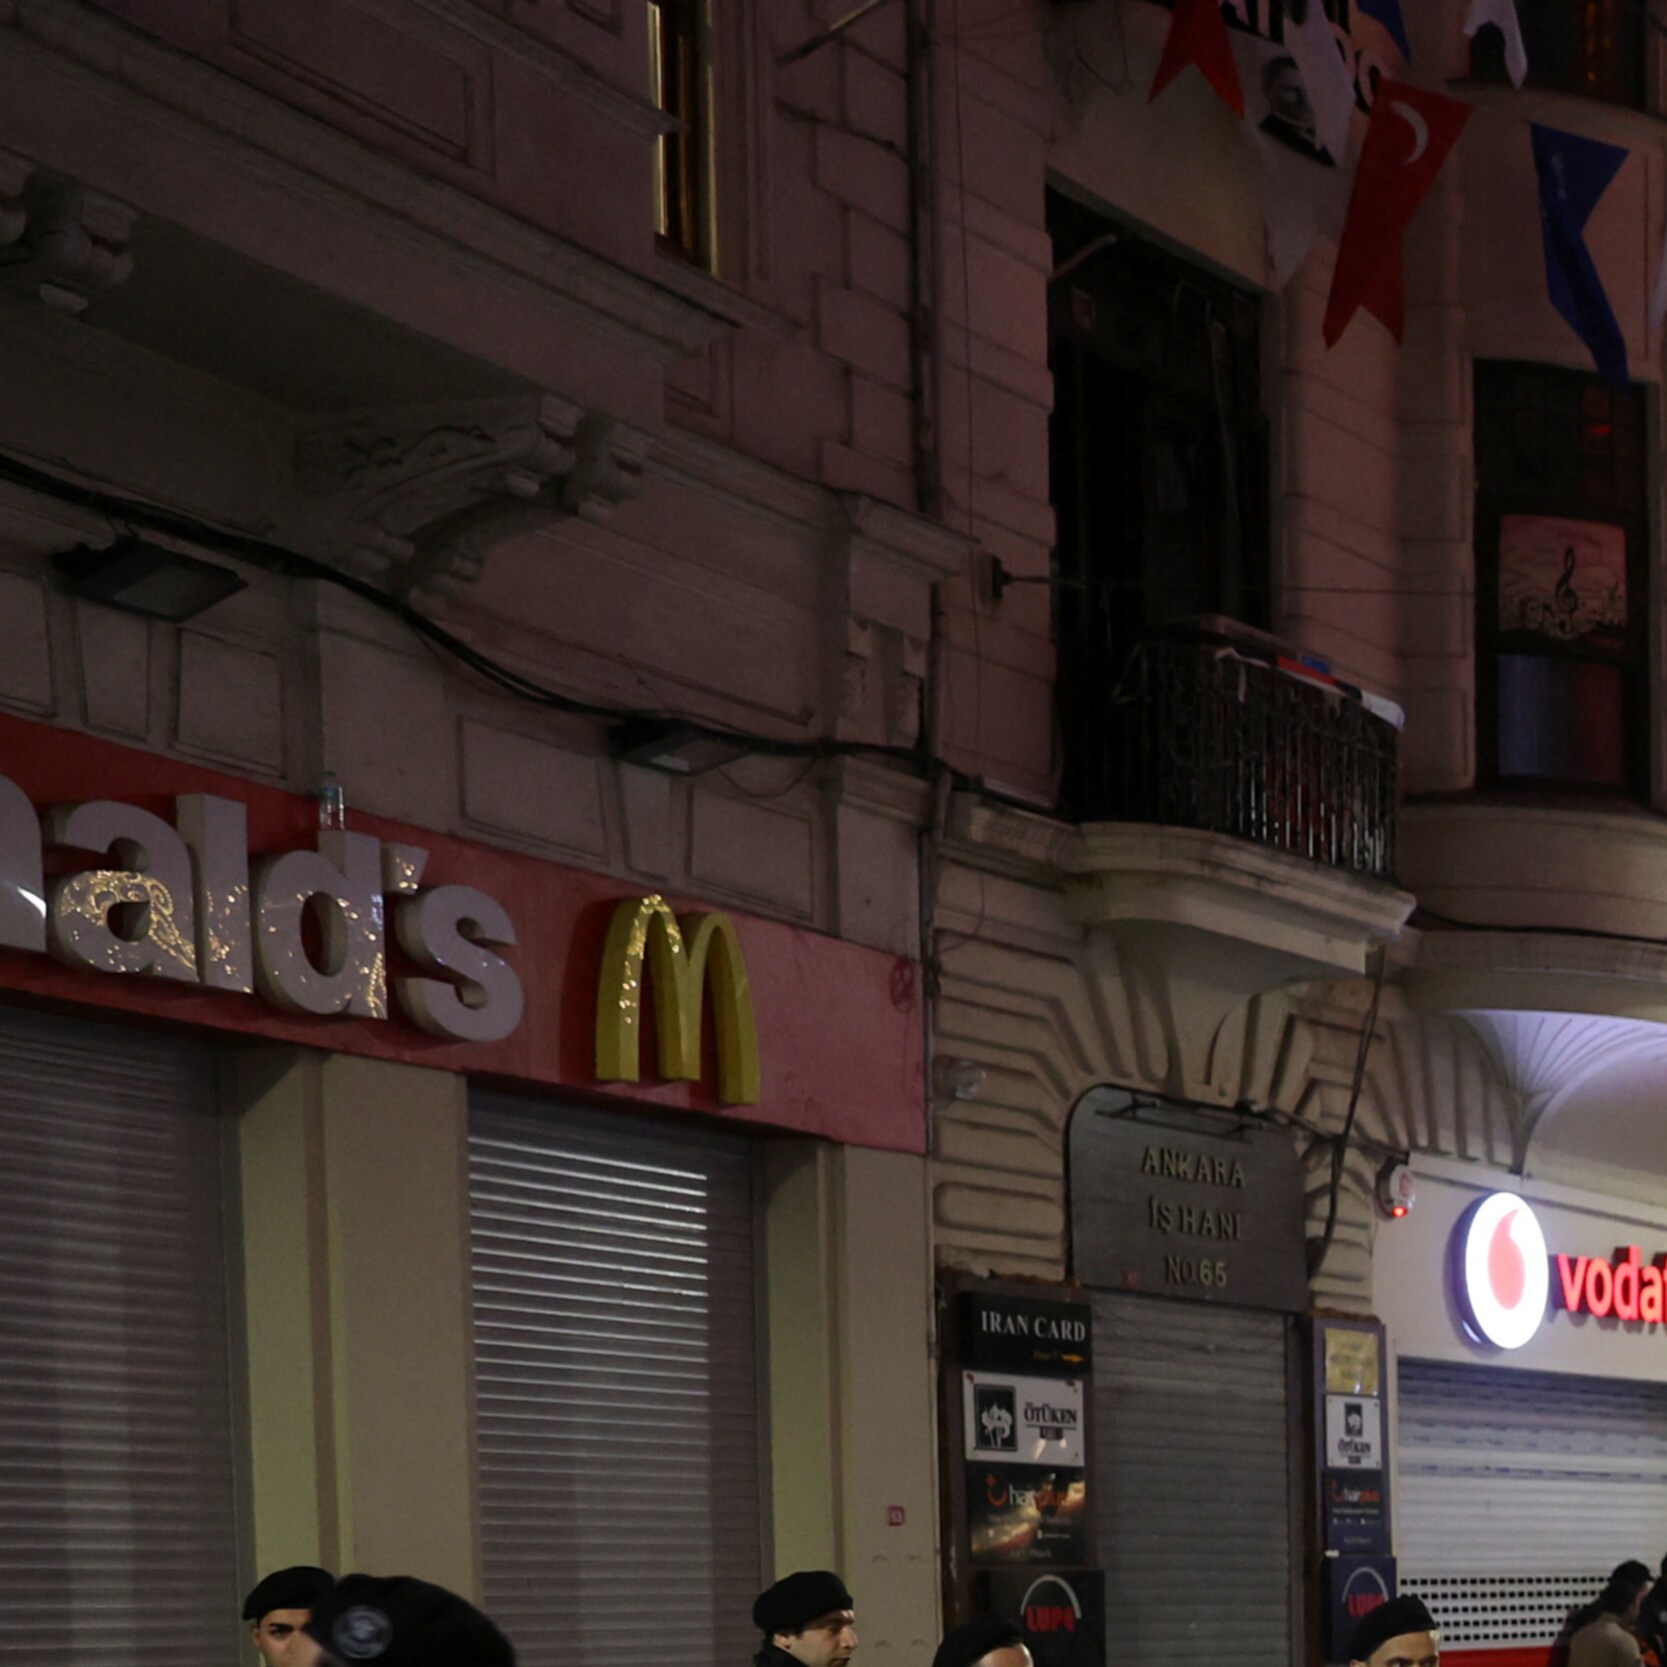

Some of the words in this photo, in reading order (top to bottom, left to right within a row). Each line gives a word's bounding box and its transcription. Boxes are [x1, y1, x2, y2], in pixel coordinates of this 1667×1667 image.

[1141, 1147, 1246, 1188] ANKARA
[1178, 1205, 1241, 1241] HANI
[981, 1310, 1029, 1336] IRAN
[1033, 1315, 1087, 1342] CARD
[1024, 1402, 1078, 1425] ÖTÜKEN
